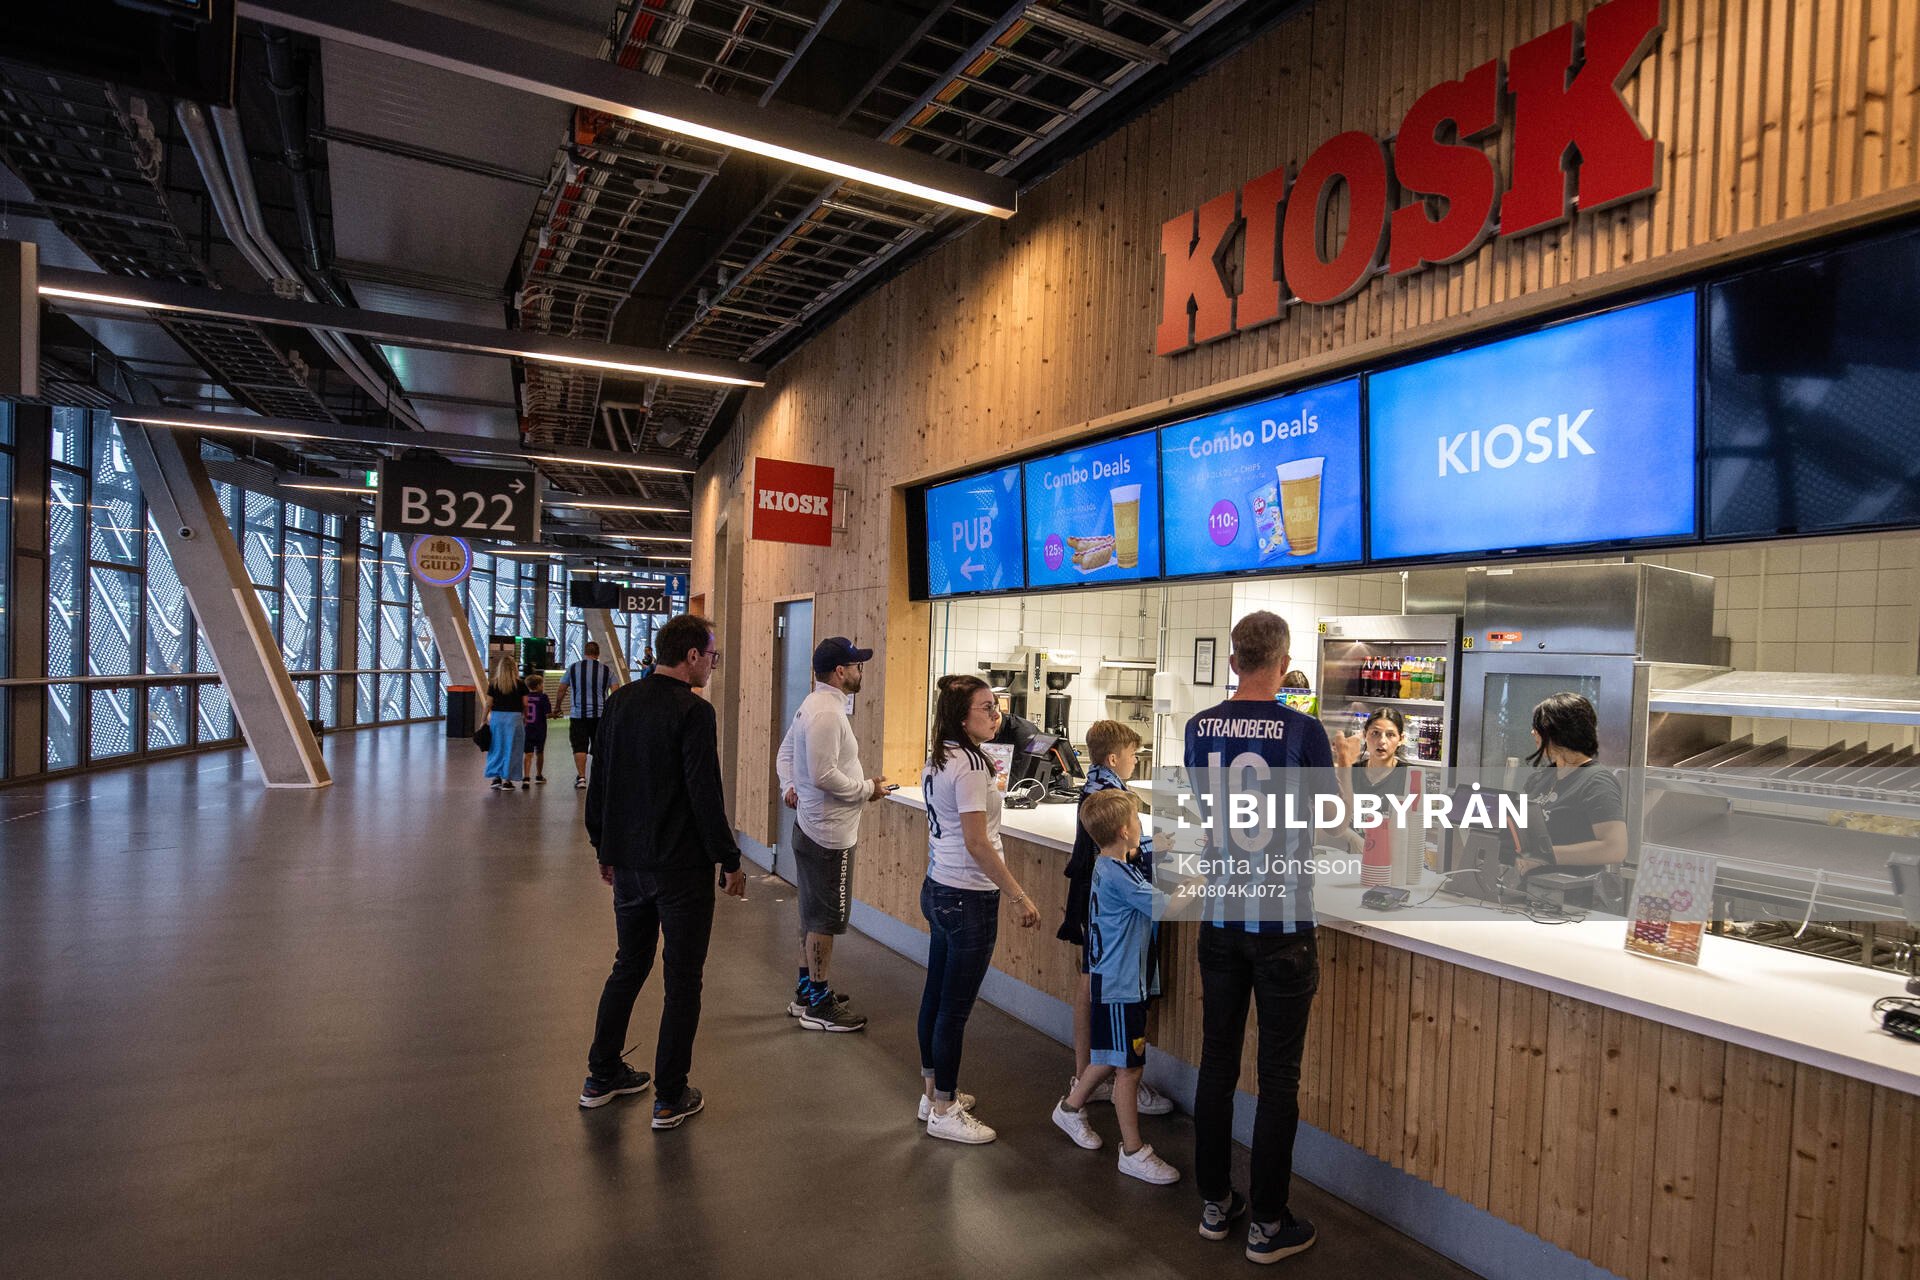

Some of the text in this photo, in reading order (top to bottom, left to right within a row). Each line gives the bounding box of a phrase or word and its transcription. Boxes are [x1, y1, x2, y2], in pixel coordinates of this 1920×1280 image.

[1157, 0, 1662, 356] KIOSK
[1189, 408, 1319, 458] Combo Deals
[1438, 408, 1597, 478] KIOSK
[1043, 453, 1131, 490] Combo Deals
[400, 486, 516, 532] B322
[758, 489, 829, 517] KIOSK
[1209, 512, 1238, 528] 110:-
[951, 515, 993, 553] PUB
[420, 560, 461, 571] GULD
[627, 596, 664, 611] B321
[1463, 637, 1473, 648] 28
[1197, 718, 1285, 740] STRANDBERG
[1207, 751, 1274, 853] 16
